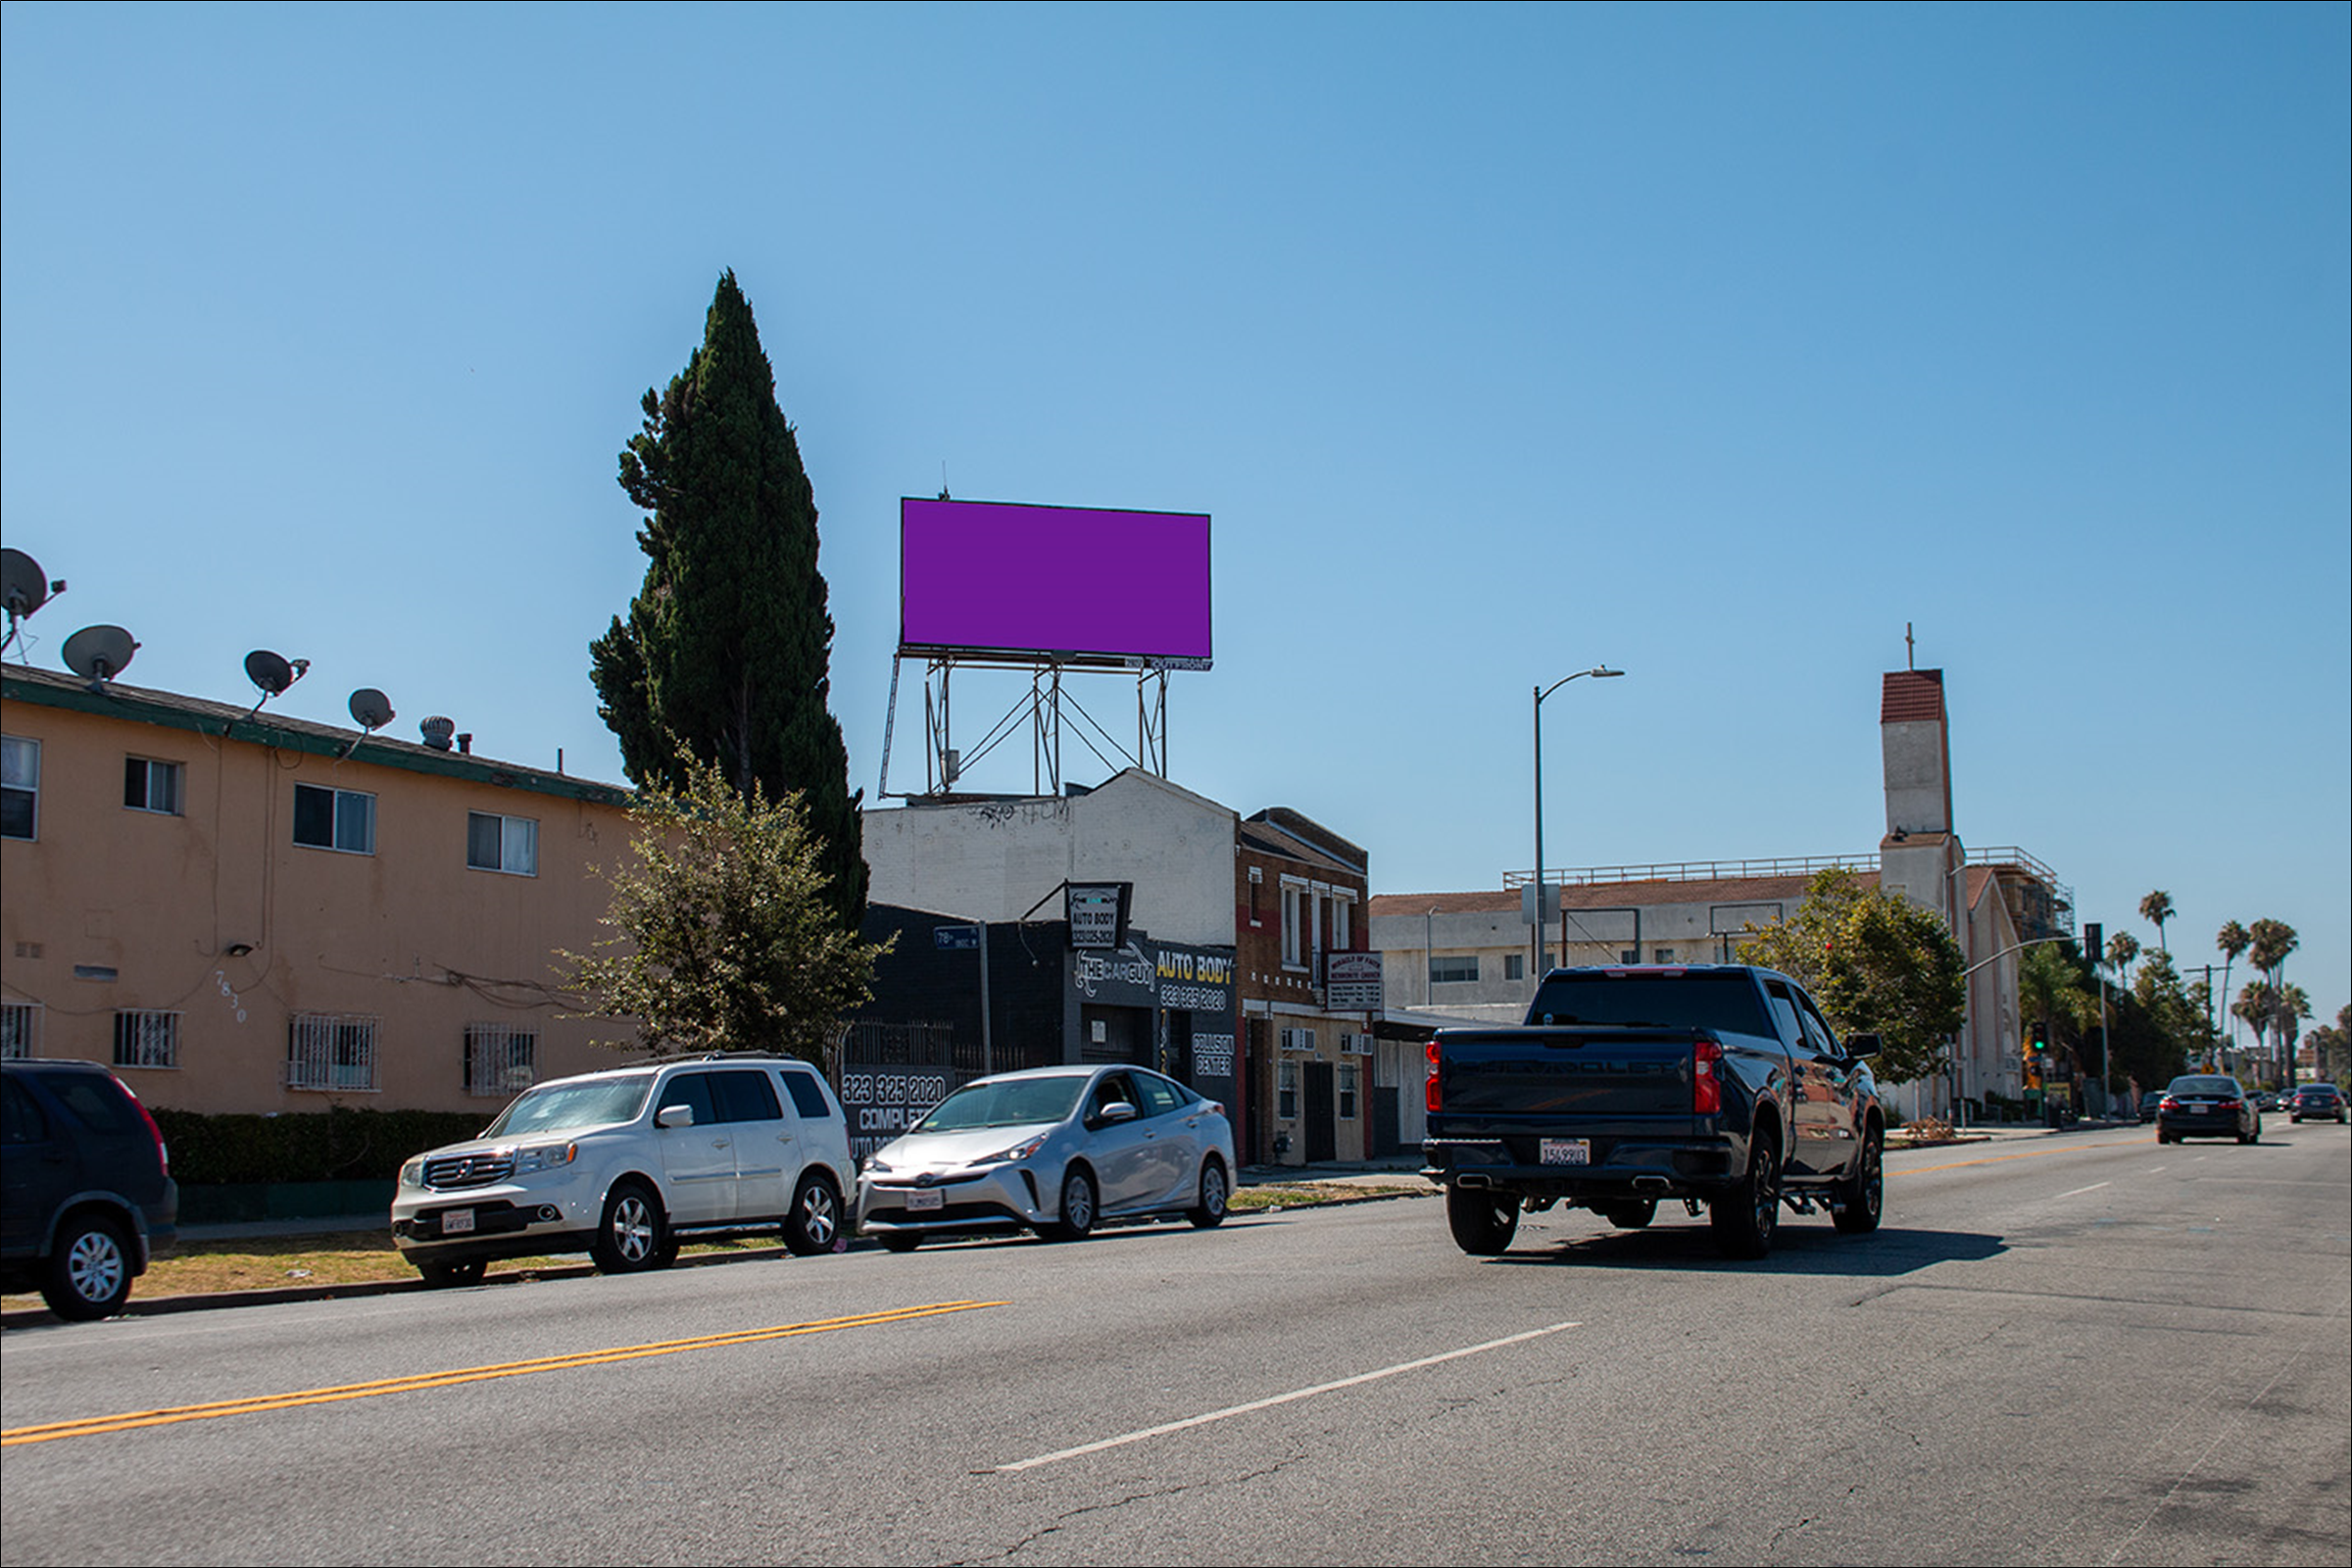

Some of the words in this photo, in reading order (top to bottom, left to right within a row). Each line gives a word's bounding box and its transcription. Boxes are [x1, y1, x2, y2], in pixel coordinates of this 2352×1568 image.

[1073, 912, 1093, 925] AUTO
[1095, 912, 1115, 925] BODY
[1156, 951, 1194, 980] AUTO
[1197, 956, 1233, 985] BODY
[215, 970, 247, 1023] 7830
[1160, 984, 1180, 1006] 323
[1181, 986, 1200, 1008] 325
[1200, 988, 1226, 1010] 2020
[843, 1074, 873, 1104] 323
[876, 1074, 906, 1105] 325
[907, 1075, 946, 1105] 2020
[859, 1108, 929, 1130] COMPLET
[850, 1136, 873, 1158] UTO
